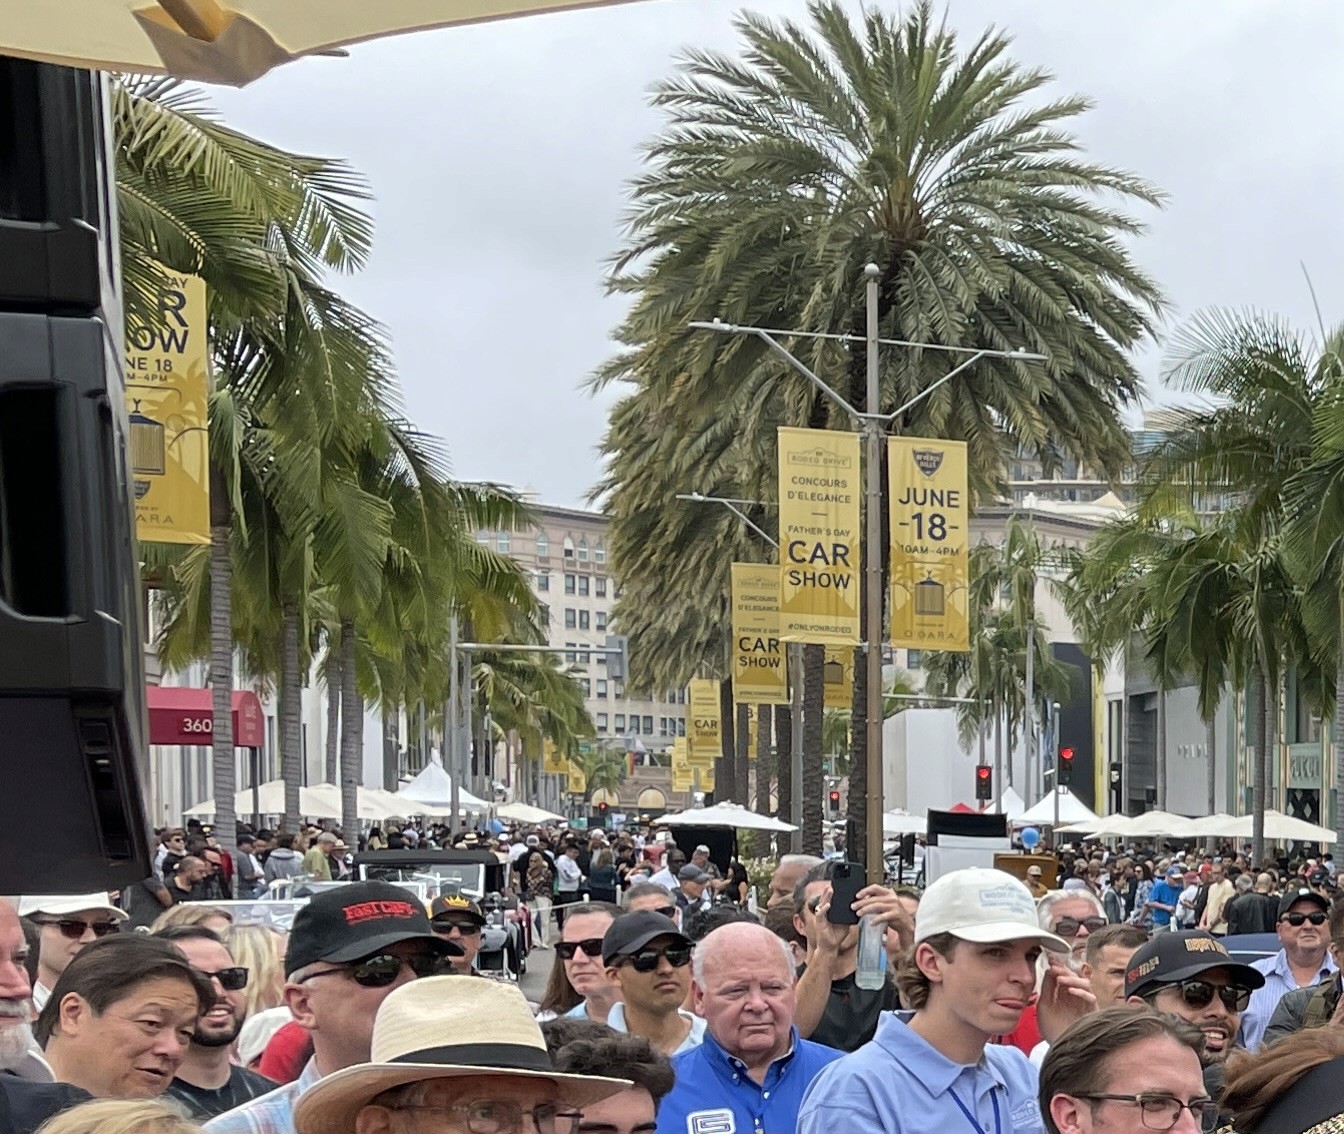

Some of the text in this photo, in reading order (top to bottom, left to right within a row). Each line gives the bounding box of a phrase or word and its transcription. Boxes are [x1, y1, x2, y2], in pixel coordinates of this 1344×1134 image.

[126, 326, 189, 354] OW
[125, 357, 173, 373] NE 18
[791, 476, 848, 489] CONCOURS
[787, 491, 851, 504] D'ELEGANCE
[898, 487, 960, 509] JUNE
[788, 525, 850, 538] FATHER'S DAY
[788, 540, 851, 568] CAR
[789, 570, 851, 589] SHOW
[738, 637, 780, 655] CAR
[738, 656, 781, 669] SHOW
[183, 718, 212, 733] 360
[694, 719, 718, 730] CAR
